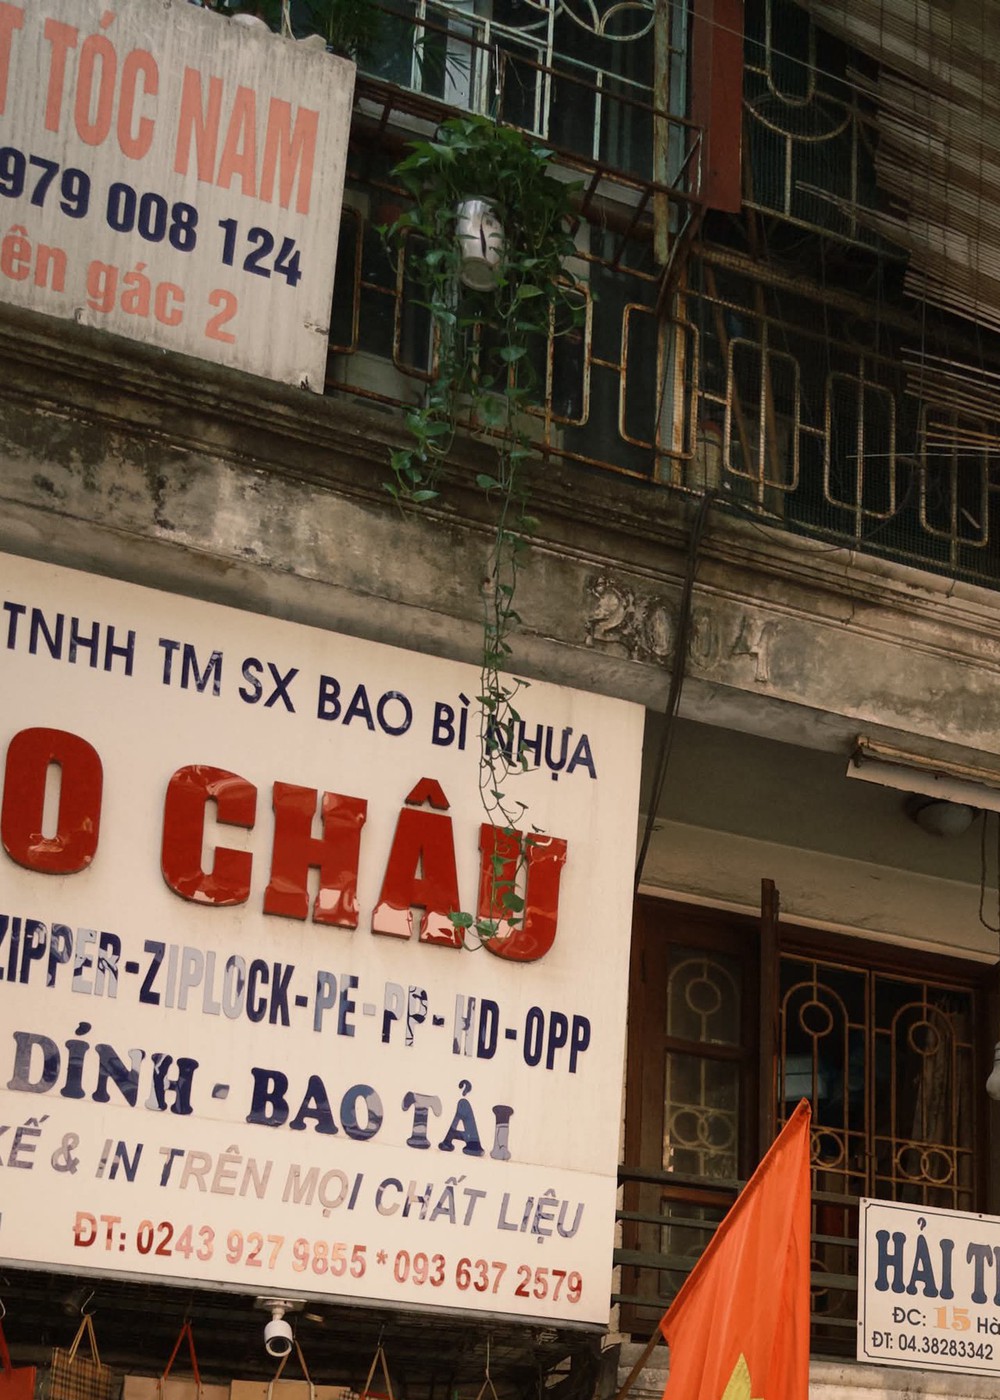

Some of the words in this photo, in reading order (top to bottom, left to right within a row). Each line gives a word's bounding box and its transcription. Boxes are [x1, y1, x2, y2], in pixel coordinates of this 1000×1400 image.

[44, 9, 160, 161] TÓC
[173, 65, 320, 216] NAM
[106, 182, 199, 252] 008
[218, 217, 303, 287] 124
[84, 261, 186, 327] gác
[204, 288, 239, 345] 2
[3, 602, 136, 676] TNHH
[159, 637, 224, 698] TM
[238, 657, 300, 713] SX
[317, 675, 414, 736] BAO
[431, 693, 470, 751] BÌ
[486, 712, 598, 782] NHỰA
[1, 726, 104, 875] O
[161, 764, 569, 963] CHÂU
[6, 1022, 200, 1116] DÍNH
[246, 1067, 385, 1141] BAO
[401, 1079, 515, 1161] TẢI
[50, 1132, 79, 1175] &
[96, 1138, 144, 1183] IN
[158, 1145, 275, 1198] TRÊN
[282, 1164, 365, 1218] MỌI
[375, 1175, 488, 1229] CHẤT
[497, 1188, 586, 1245] LIỆU
[72, 1211, 126, 1254] ĐT:
[136, 1218, 216, 1263] 0243
[226, 1228, 285, 1271] 927
[292, 1238, 367, 1280] 9855
[393, 1249, 446, 1288] 093
[455, 1256, 507, 1296] 637
[515, 1263, 584, 1305] 2579
[874, 1216, 955, 1300] HẢI
[871, 1330, 893, 1350] ĐT:
[898, 1334, 994, 1361] 04.38283342
[892, 1306, 927, 1327] ĐC:
[933, 1305, 971, 1332] 15
